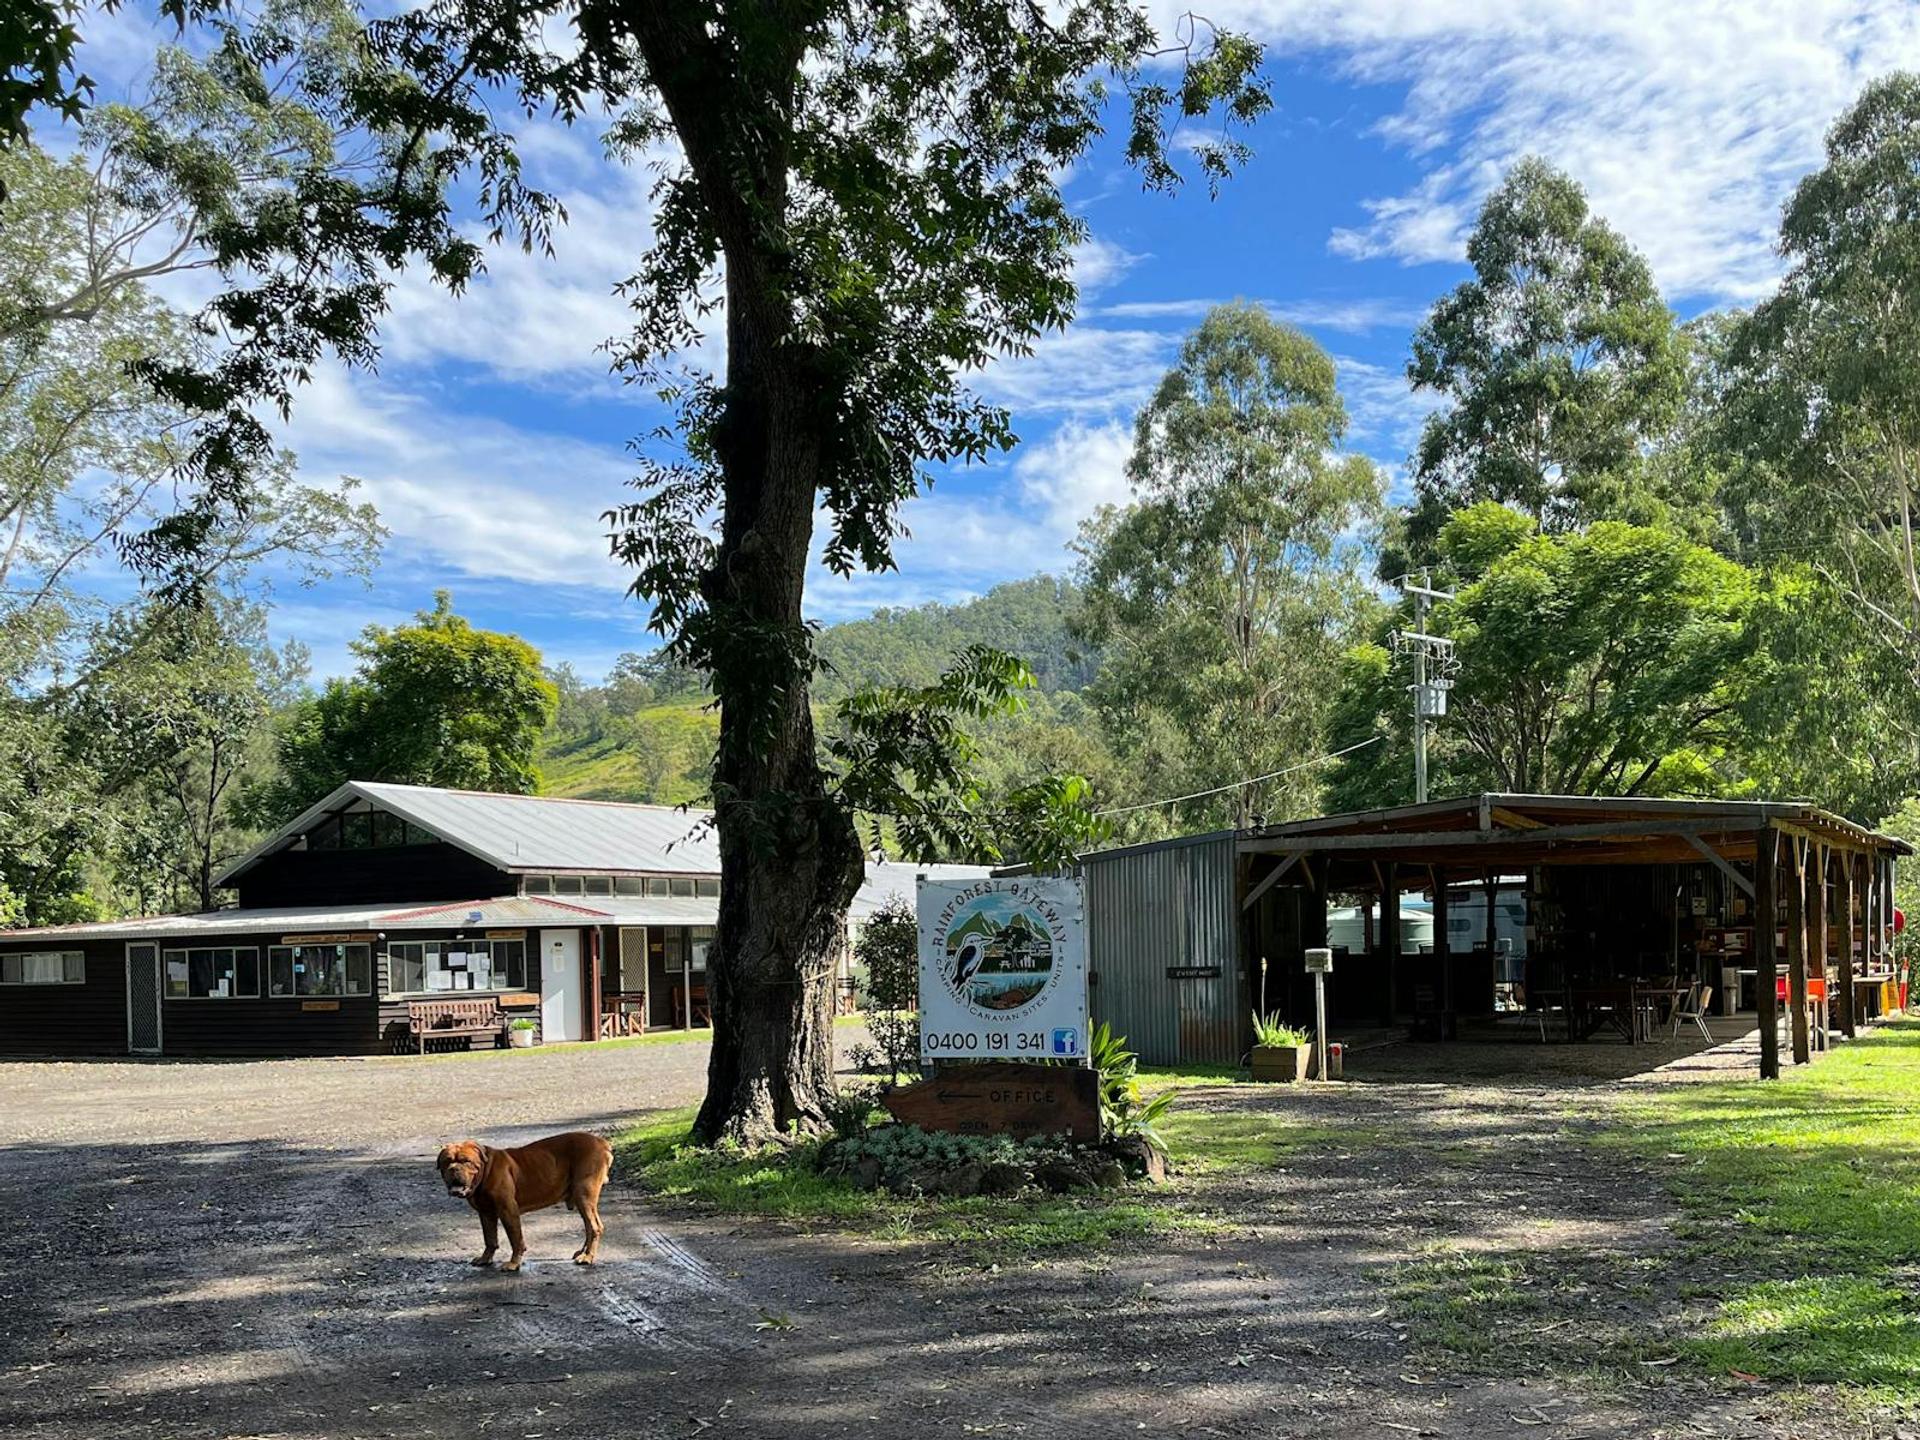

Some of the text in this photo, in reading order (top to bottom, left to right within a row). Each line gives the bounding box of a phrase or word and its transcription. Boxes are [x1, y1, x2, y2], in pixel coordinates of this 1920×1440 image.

[932, 880, 1068, 947] RAINFOREST GATEWAY
[936, 955, 1066, 1023] CAMPING CARAVAN SITES UNITS
[927, 1032, 1045, 1051] 0400 191 341
[990, 1090, 1056, 1103] OFFICE
